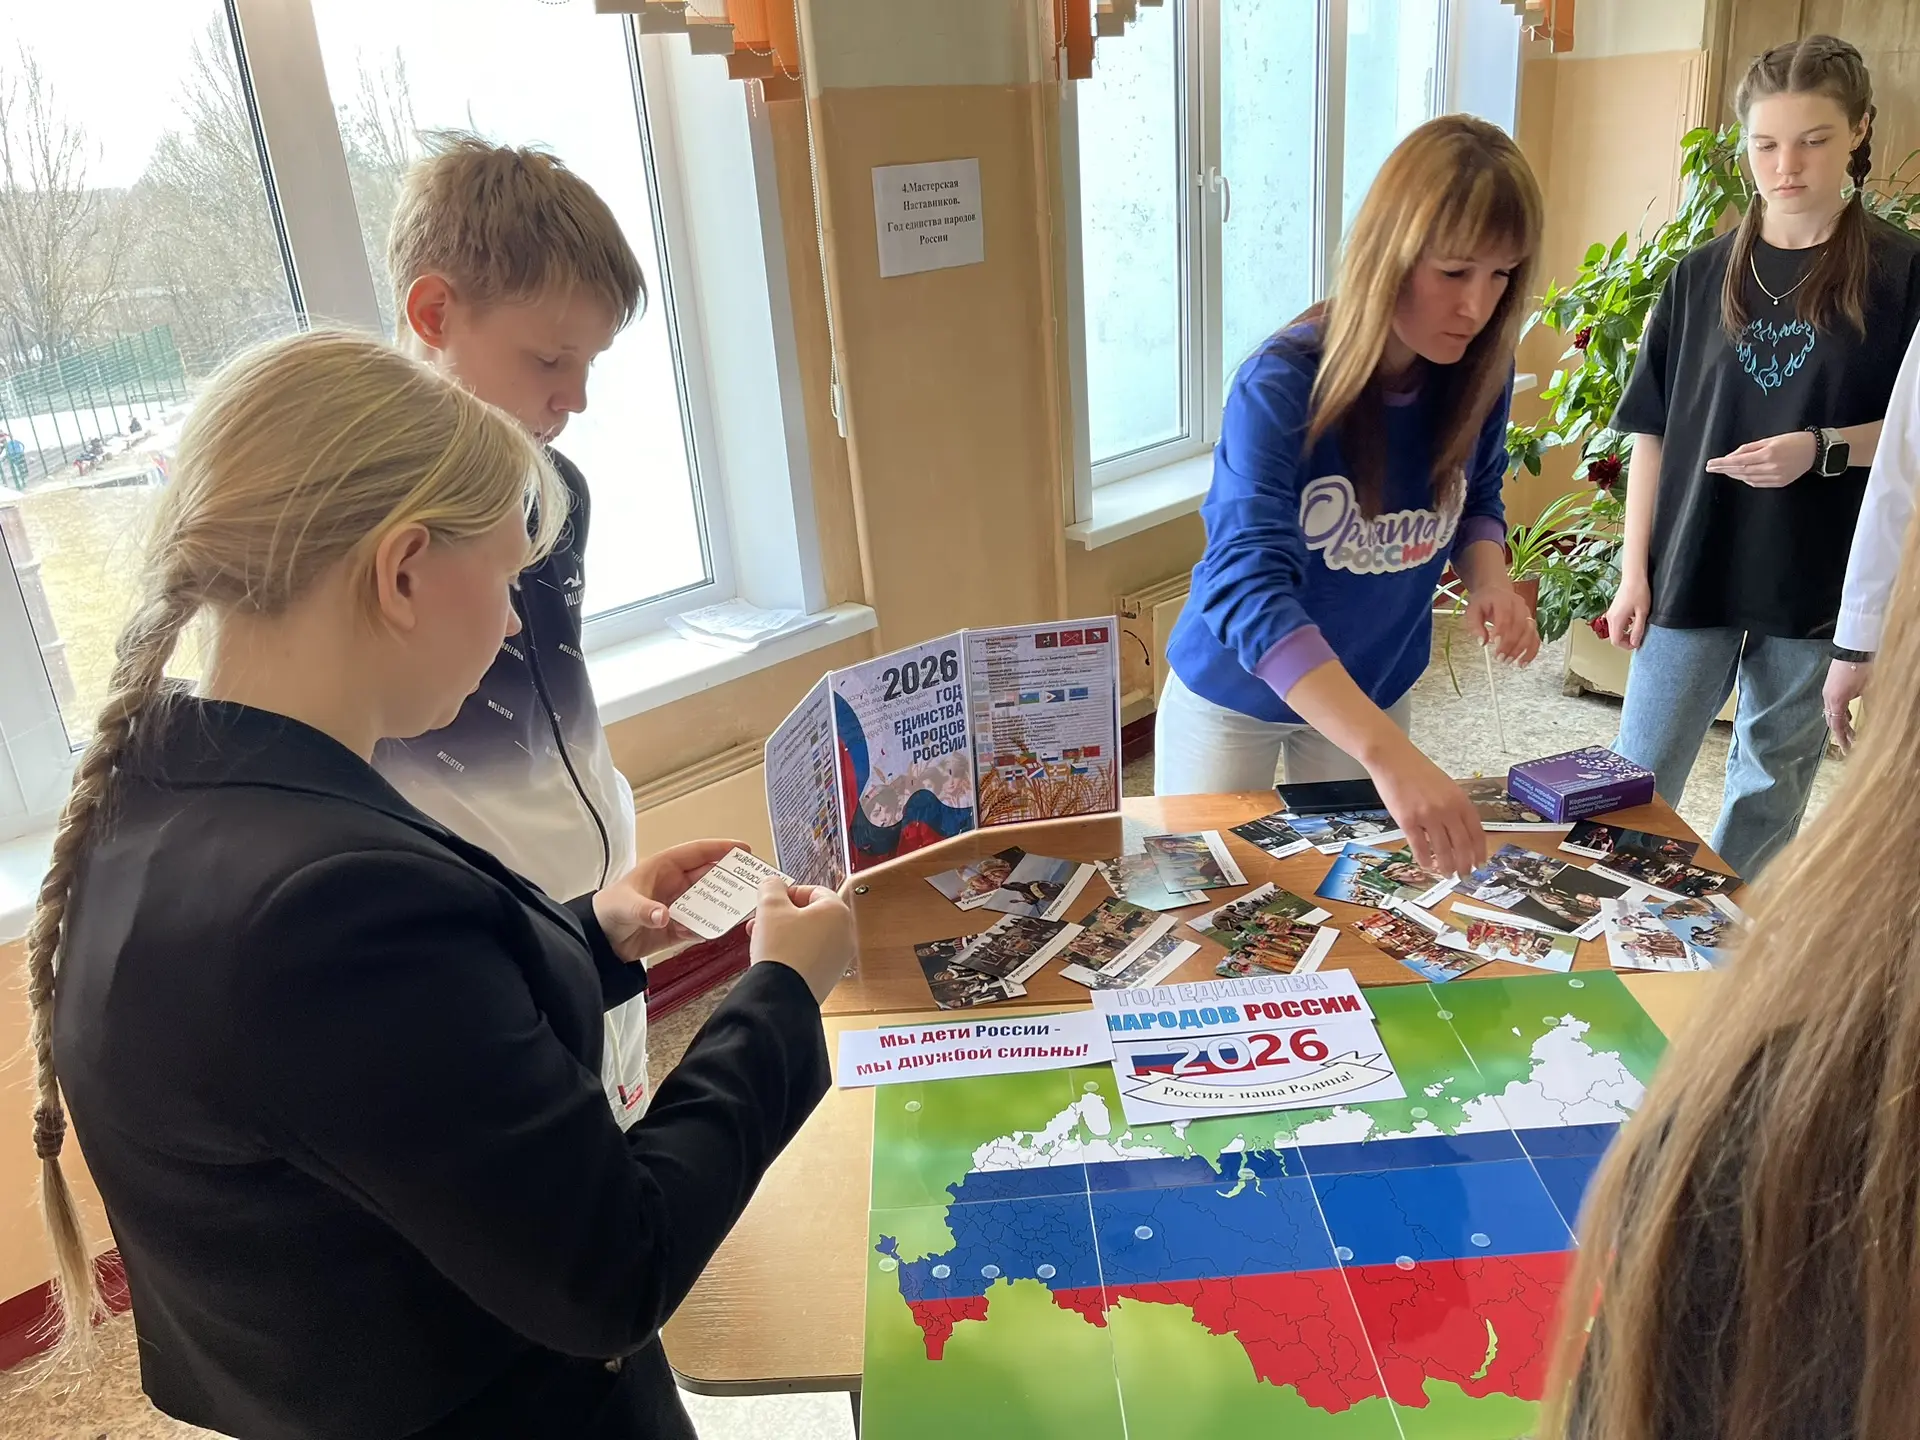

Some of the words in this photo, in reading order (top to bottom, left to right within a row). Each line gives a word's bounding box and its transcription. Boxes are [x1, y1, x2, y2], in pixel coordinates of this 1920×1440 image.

[902, 180, 959, 193] 4.Мастерская
[903, 198, 960, 211] Наставников.
[887, 222, 904, 232] Год
[905, 218, 942, 230] единства
[944, 213, 976, 226] народов
[919, 234, 948, 245] России
[882, 649, 958, 702] 2026
[936, 684, 963, 704] ГОД
[487, 699, 514, 720] HOLLISTER
[894, 702, 964, 736] ЕДИНСТВА
[902, 719, 965, 751] НАРОДОВ
[437, 750, 465, 773] HOLLISTER
[913, 735, 967, 764] РОССИИ
[713, 871, 741, 889] Помощь
[733, 866, 761, 885] согласи
[1117, 986, 1175, 1007] ГОД
[1177, 973, 1328, 1004] ЕДИНСТВА
[1106, 1006, 1241, 1031] НАРОДОВ
[1243, 995, 1362, 1022] РОССИИ
[879, 1029, 915, 1048] Мы
[920, 1025, 971, 1044] дети
[975, 1023, 1050, 1038] России
[856, 1060, 892, 1076] мы
[898, 1045, 992, 1071] дружбой
[997, 1043, 1089, 1059] сильны!
[1167, 1028, 1329, 1075] 2026
[1163, 1086, 1224, 1100] Россия
[1240, 1088, 1286, 1100] наша
[1289, 1071, 1355, 1096] Родина!
